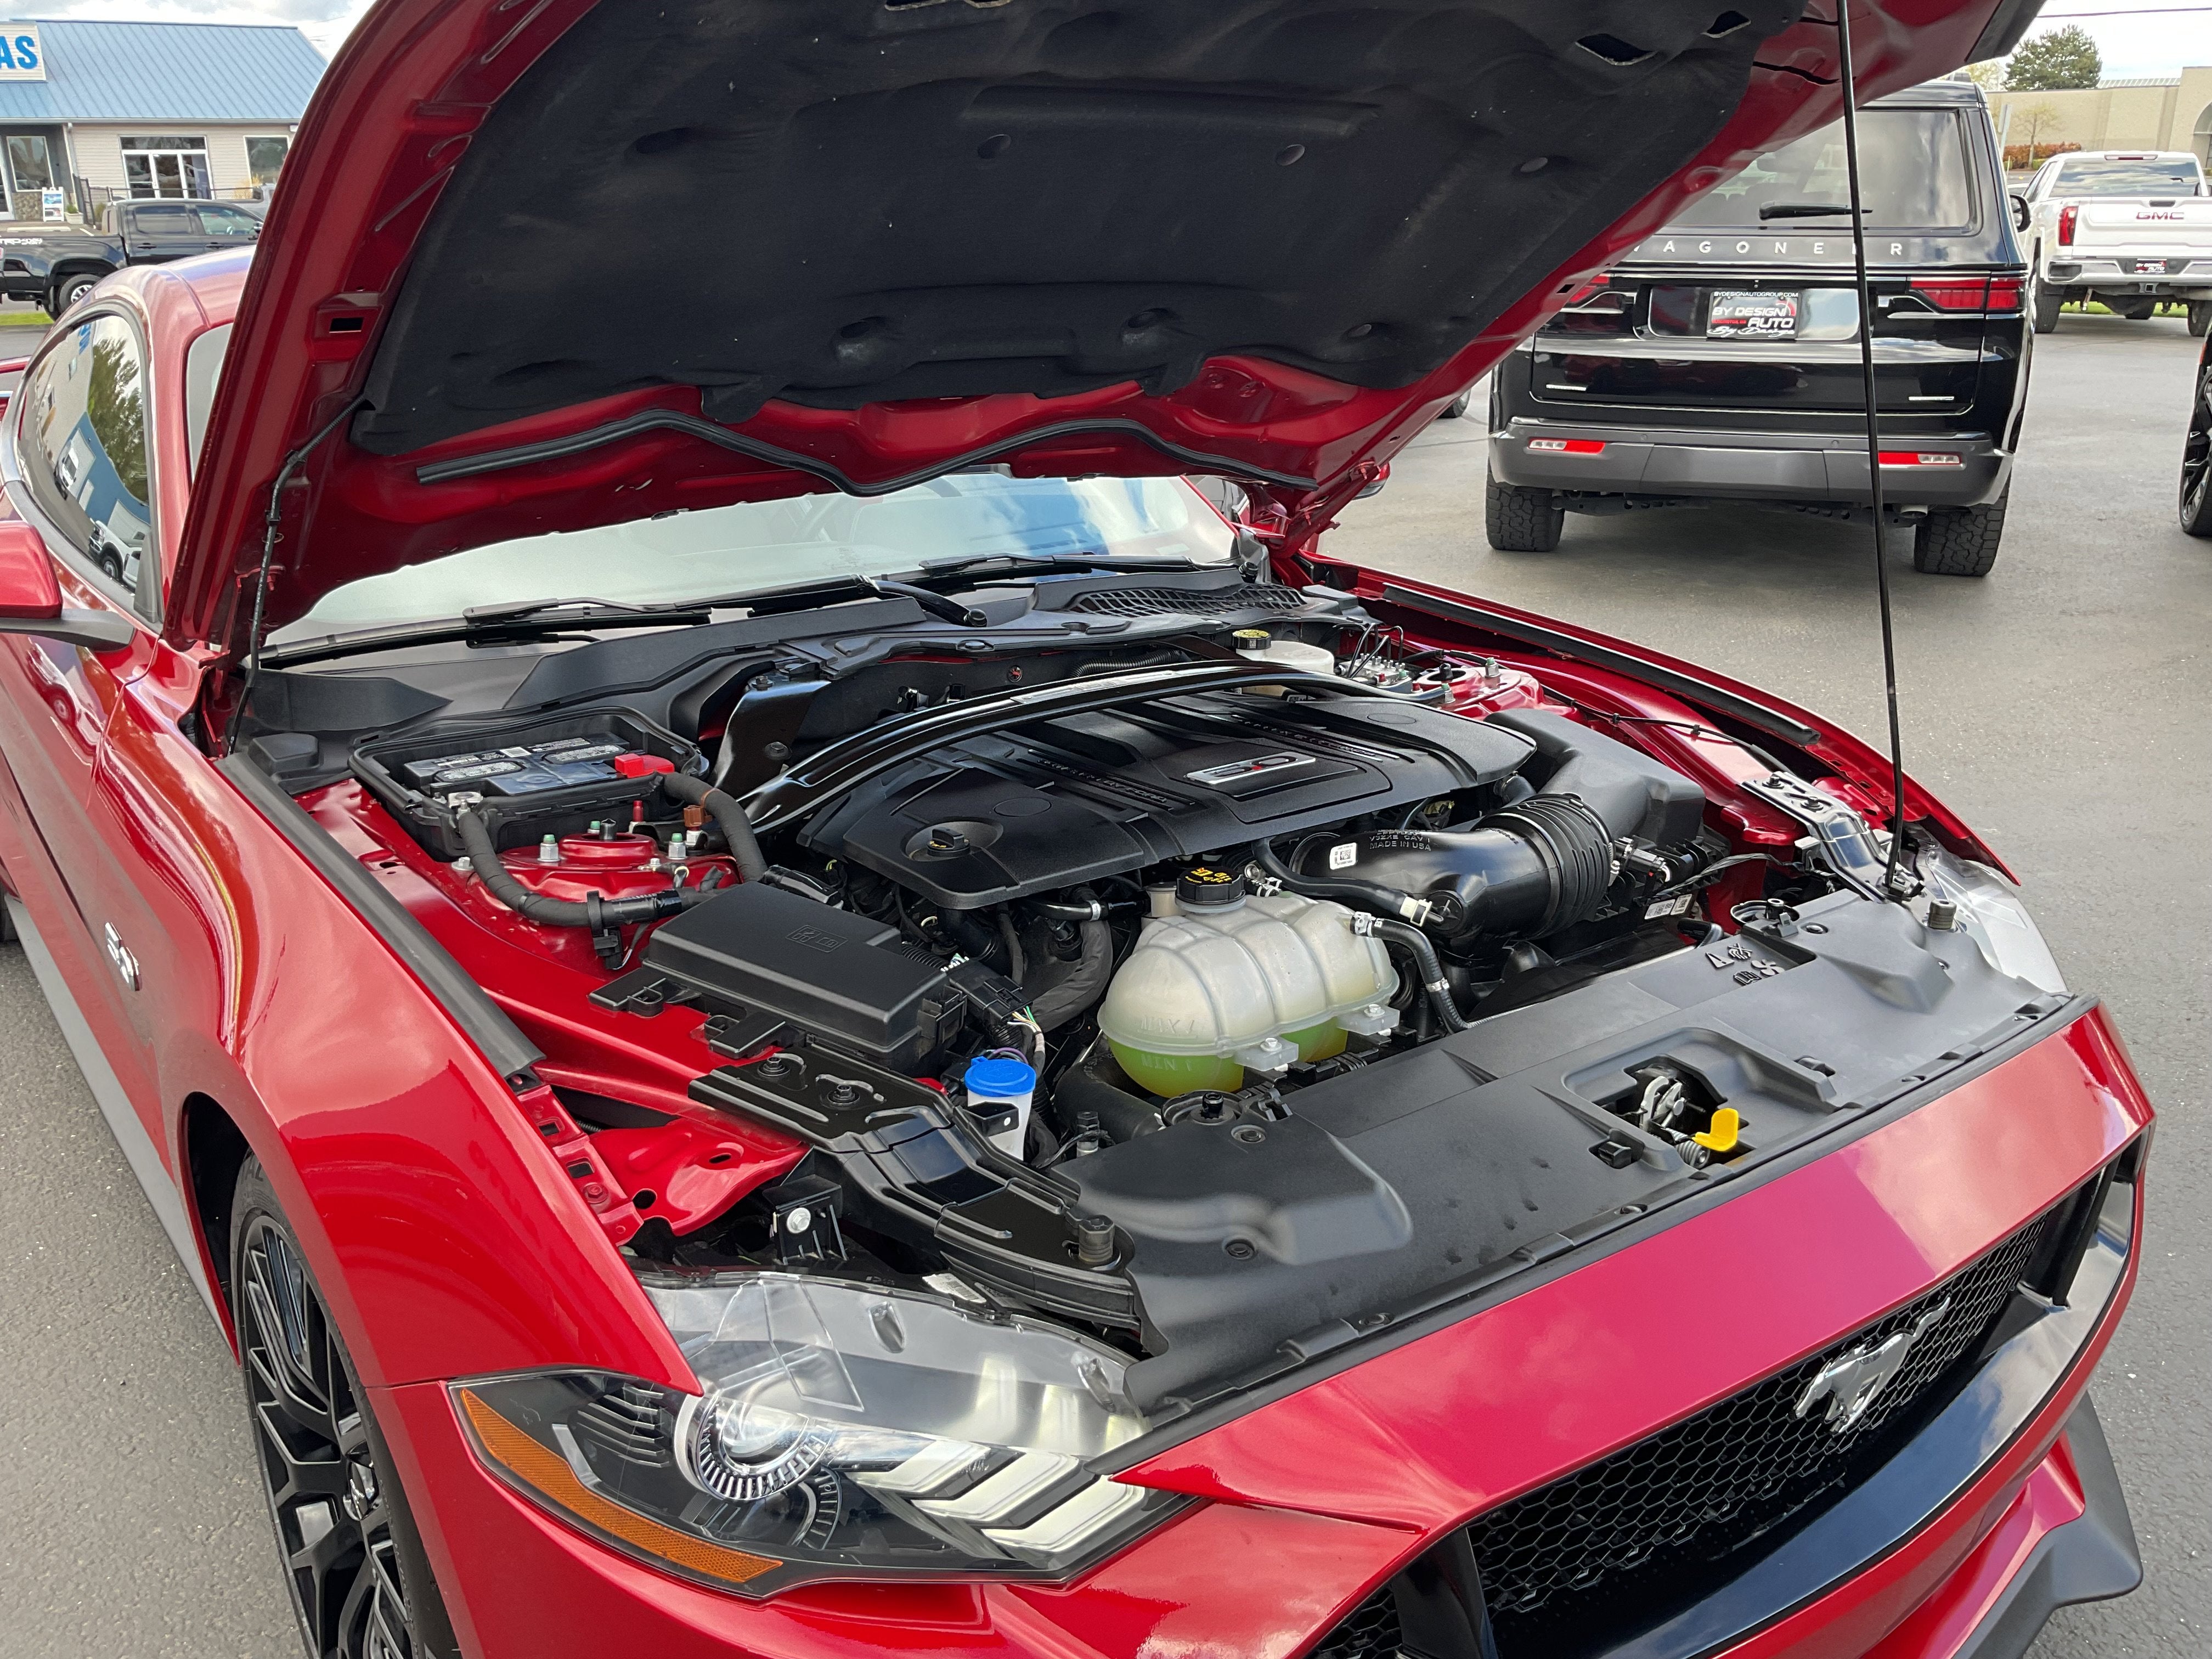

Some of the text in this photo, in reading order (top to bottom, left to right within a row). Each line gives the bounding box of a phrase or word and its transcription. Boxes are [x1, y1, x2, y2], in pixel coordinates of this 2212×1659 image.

[1633, 240, 1903, 256] AGONER
[1712, 307, 1785, 316] BY DESIGN
[1747, 317, 1794, 328] AUTO
[1369, 840, 1397, 849] MADE
[1412, 842, 1431, 851] USA
[1140, 1017, 1181, 1034] MAX
[1141, 1053, 1178, 1071] MIN
